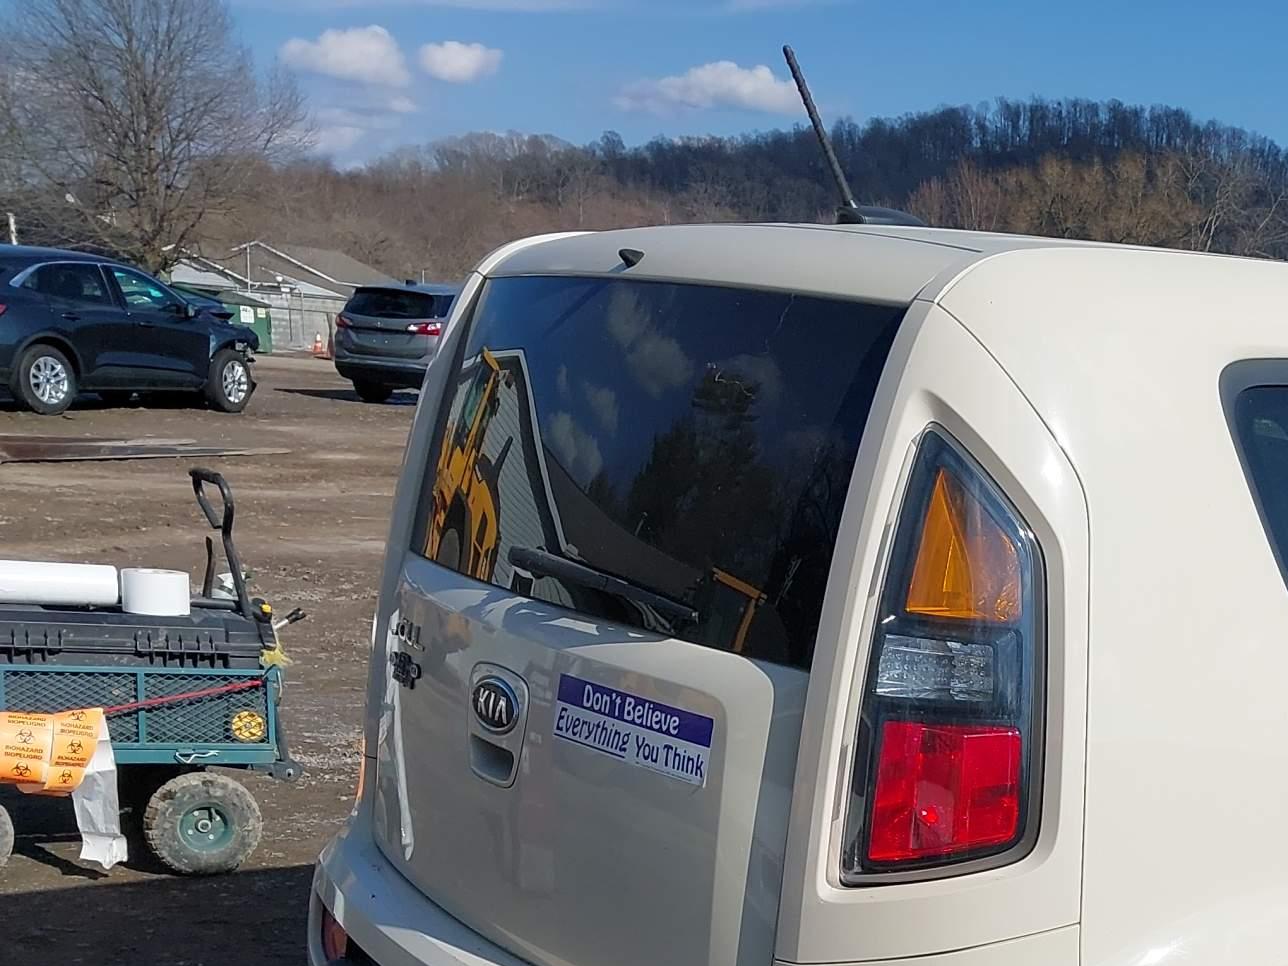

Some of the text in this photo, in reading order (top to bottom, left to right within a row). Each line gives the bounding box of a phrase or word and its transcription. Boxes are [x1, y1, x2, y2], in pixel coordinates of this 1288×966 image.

[477, 686, 507, 725] KIA
[583, 684, 680, 735] Don't Believe
[556, 707, 704, 778] Everything You Think
